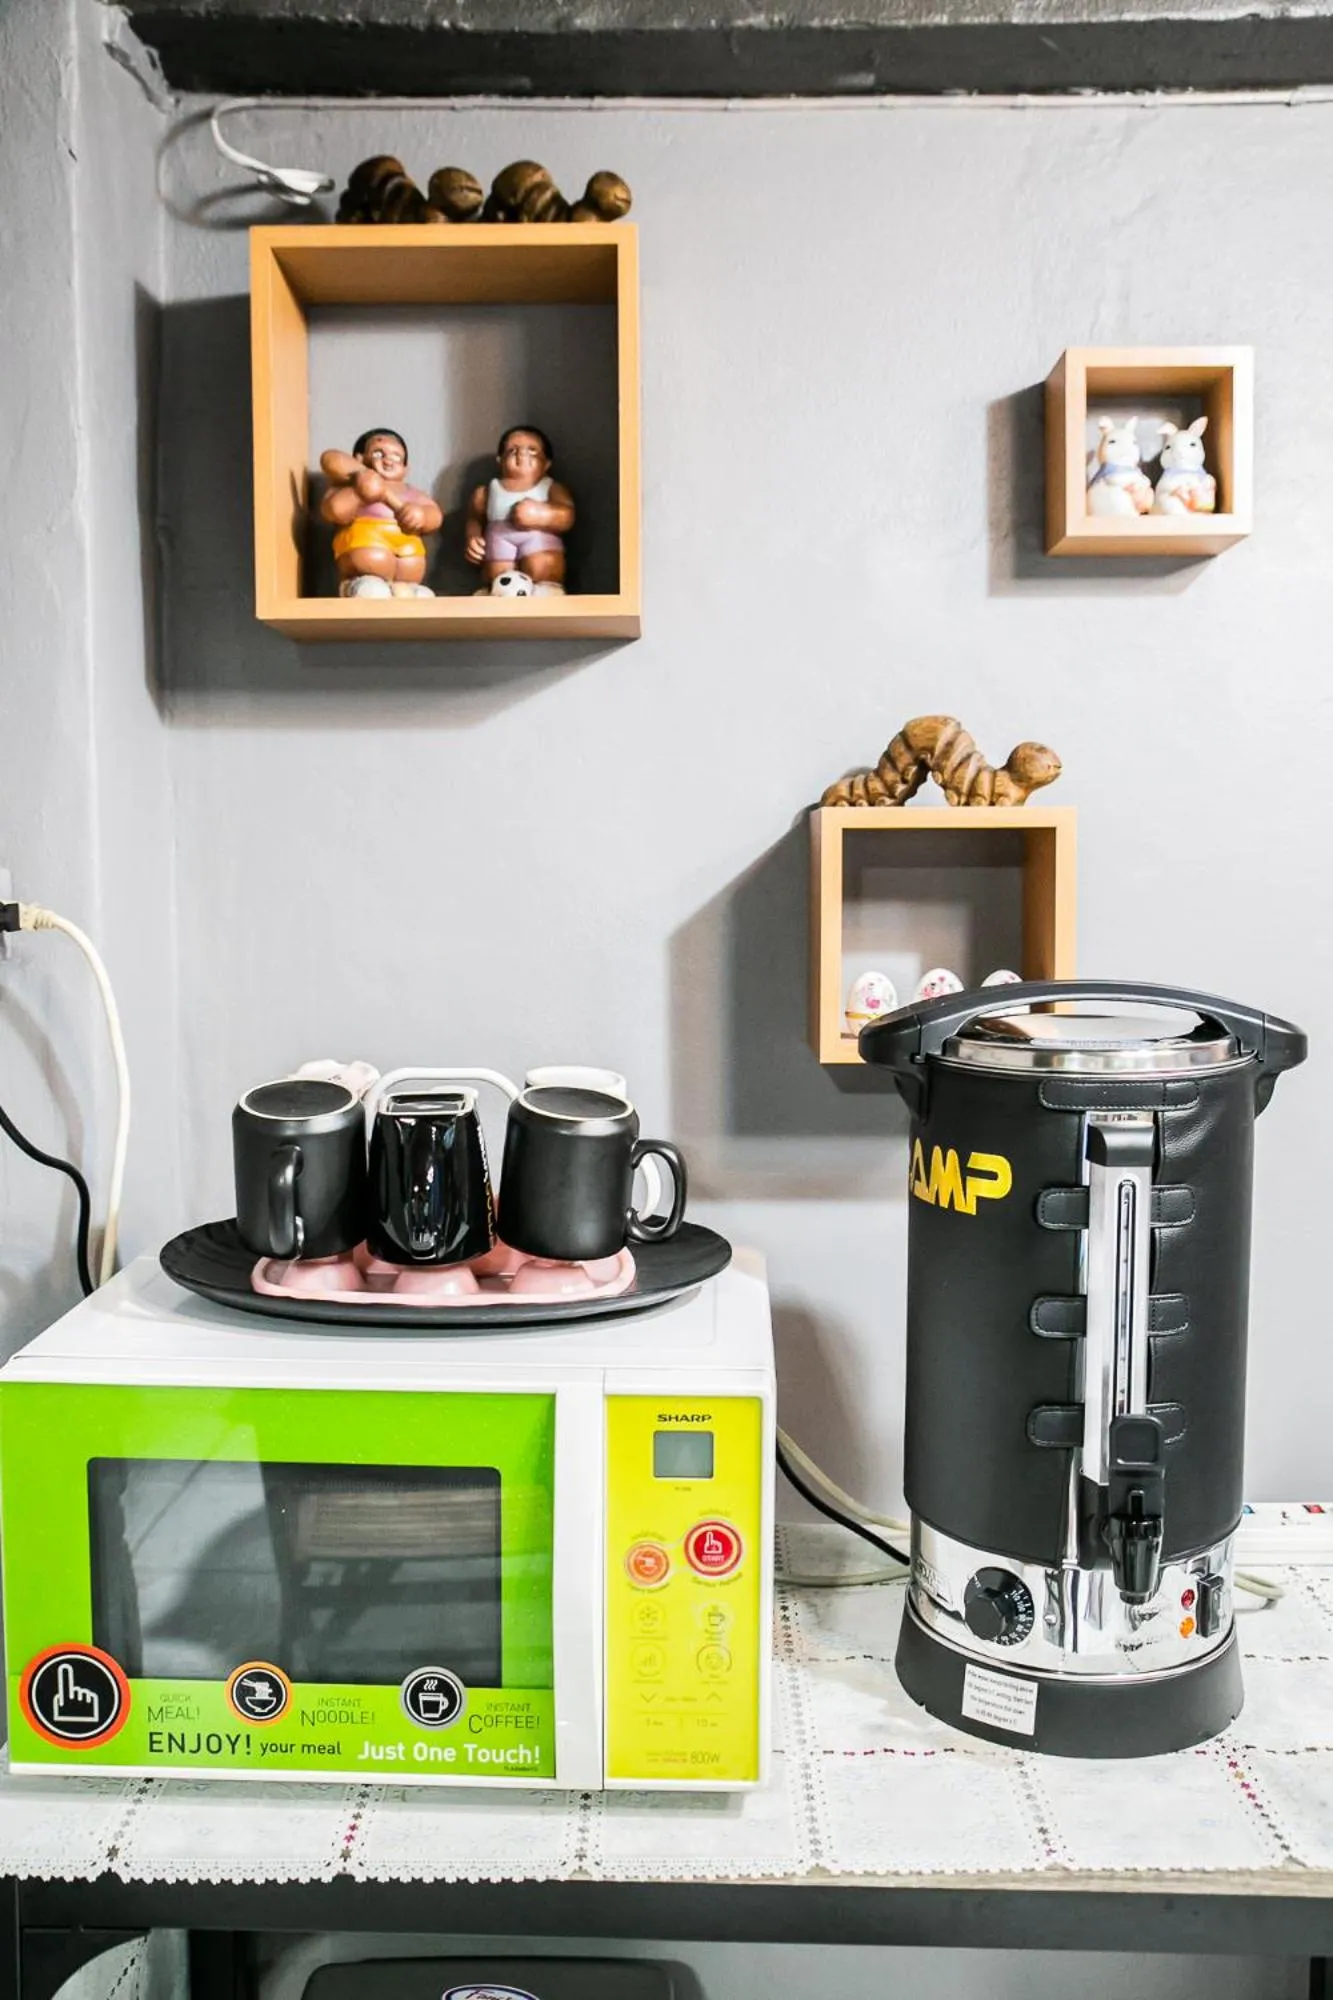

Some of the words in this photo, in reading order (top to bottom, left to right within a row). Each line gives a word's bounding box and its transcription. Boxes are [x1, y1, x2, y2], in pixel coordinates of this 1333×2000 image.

[910, 1137, 1013, 1216] AMP
[656, 1413, 713, 1423] SHARP
[318, 1697, 361, 1709] INSTANT
[485, 1702, 532, 1713] INSTANT
[147, 1705, 200, 1723] MEAL!
[300, 1709, 376, 1727] NOODLE!
[468, 1713, 540, 1734] COFFEE!
[148, 1731, 251, 1756] ENJOY!
[259, 1742, 297, 1757] your
[301, 1740, 342, 1755] meal
[357, 1740, 406, 1761] Just
[413, 1742, 457, 1763] One
[463, 1743, 541, 1765] Touch!
